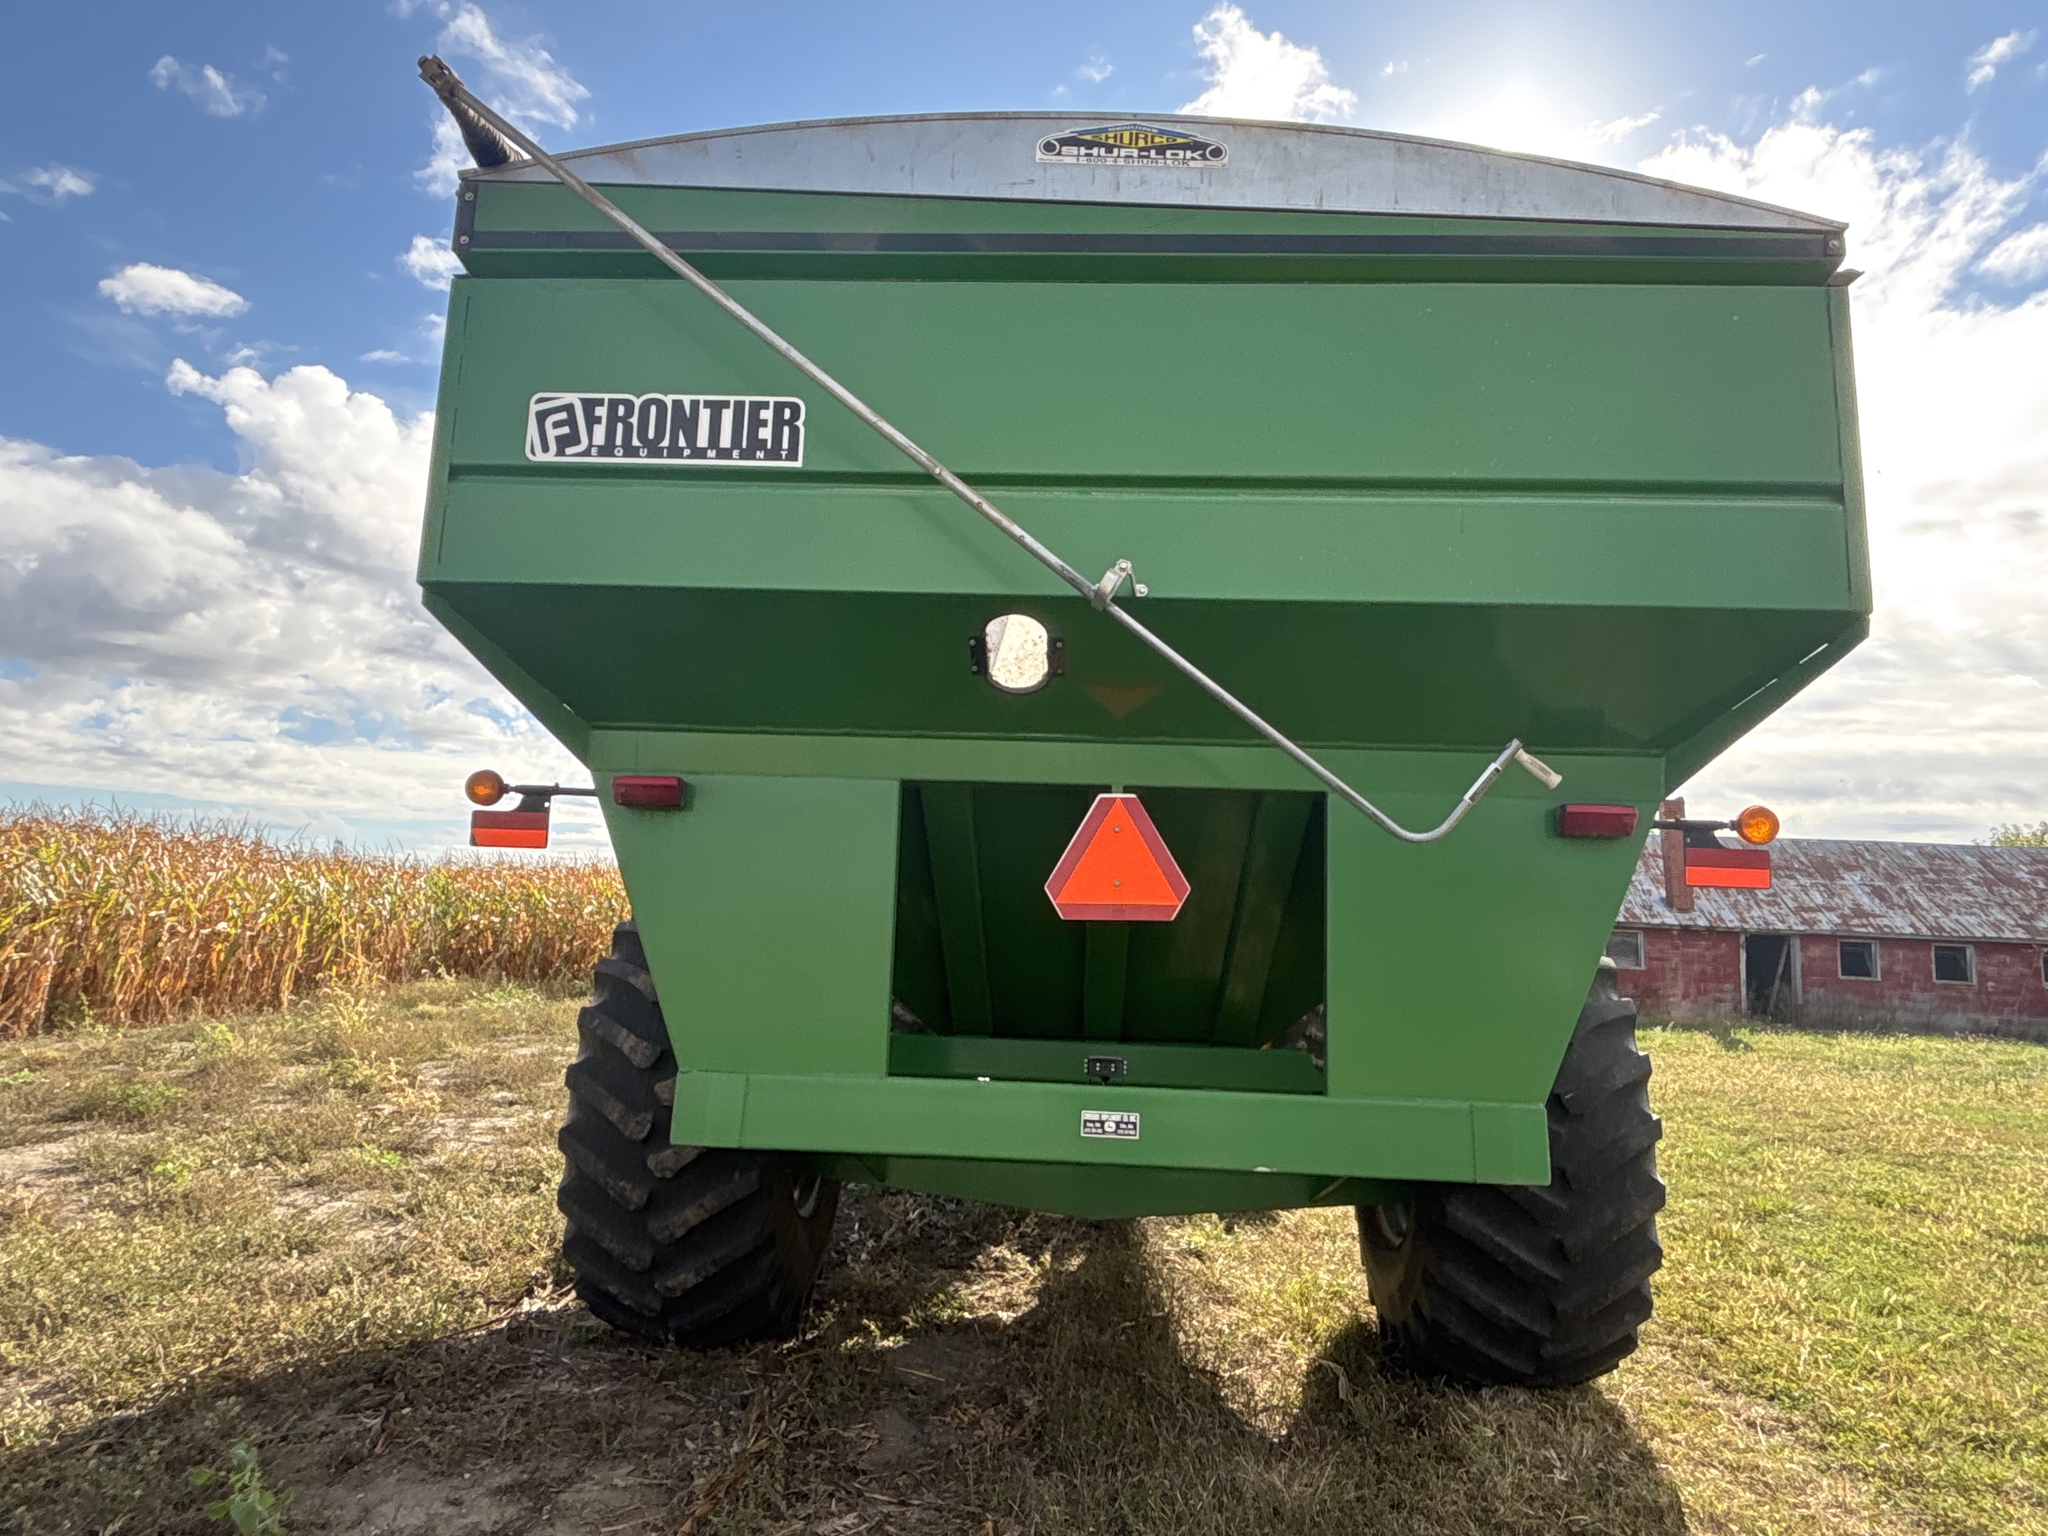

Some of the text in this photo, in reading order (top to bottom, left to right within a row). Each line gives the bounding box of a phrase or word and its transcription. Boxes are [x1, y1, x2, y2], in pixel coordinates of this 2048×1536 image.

[1090, 129, 1178, 148] SHURCO
[1060, 146, 1204, 160] SHUR-LOK
[583, 397, 801, 450] FRONTIER
[591, 447, 788, 460] EQUIPMENT
